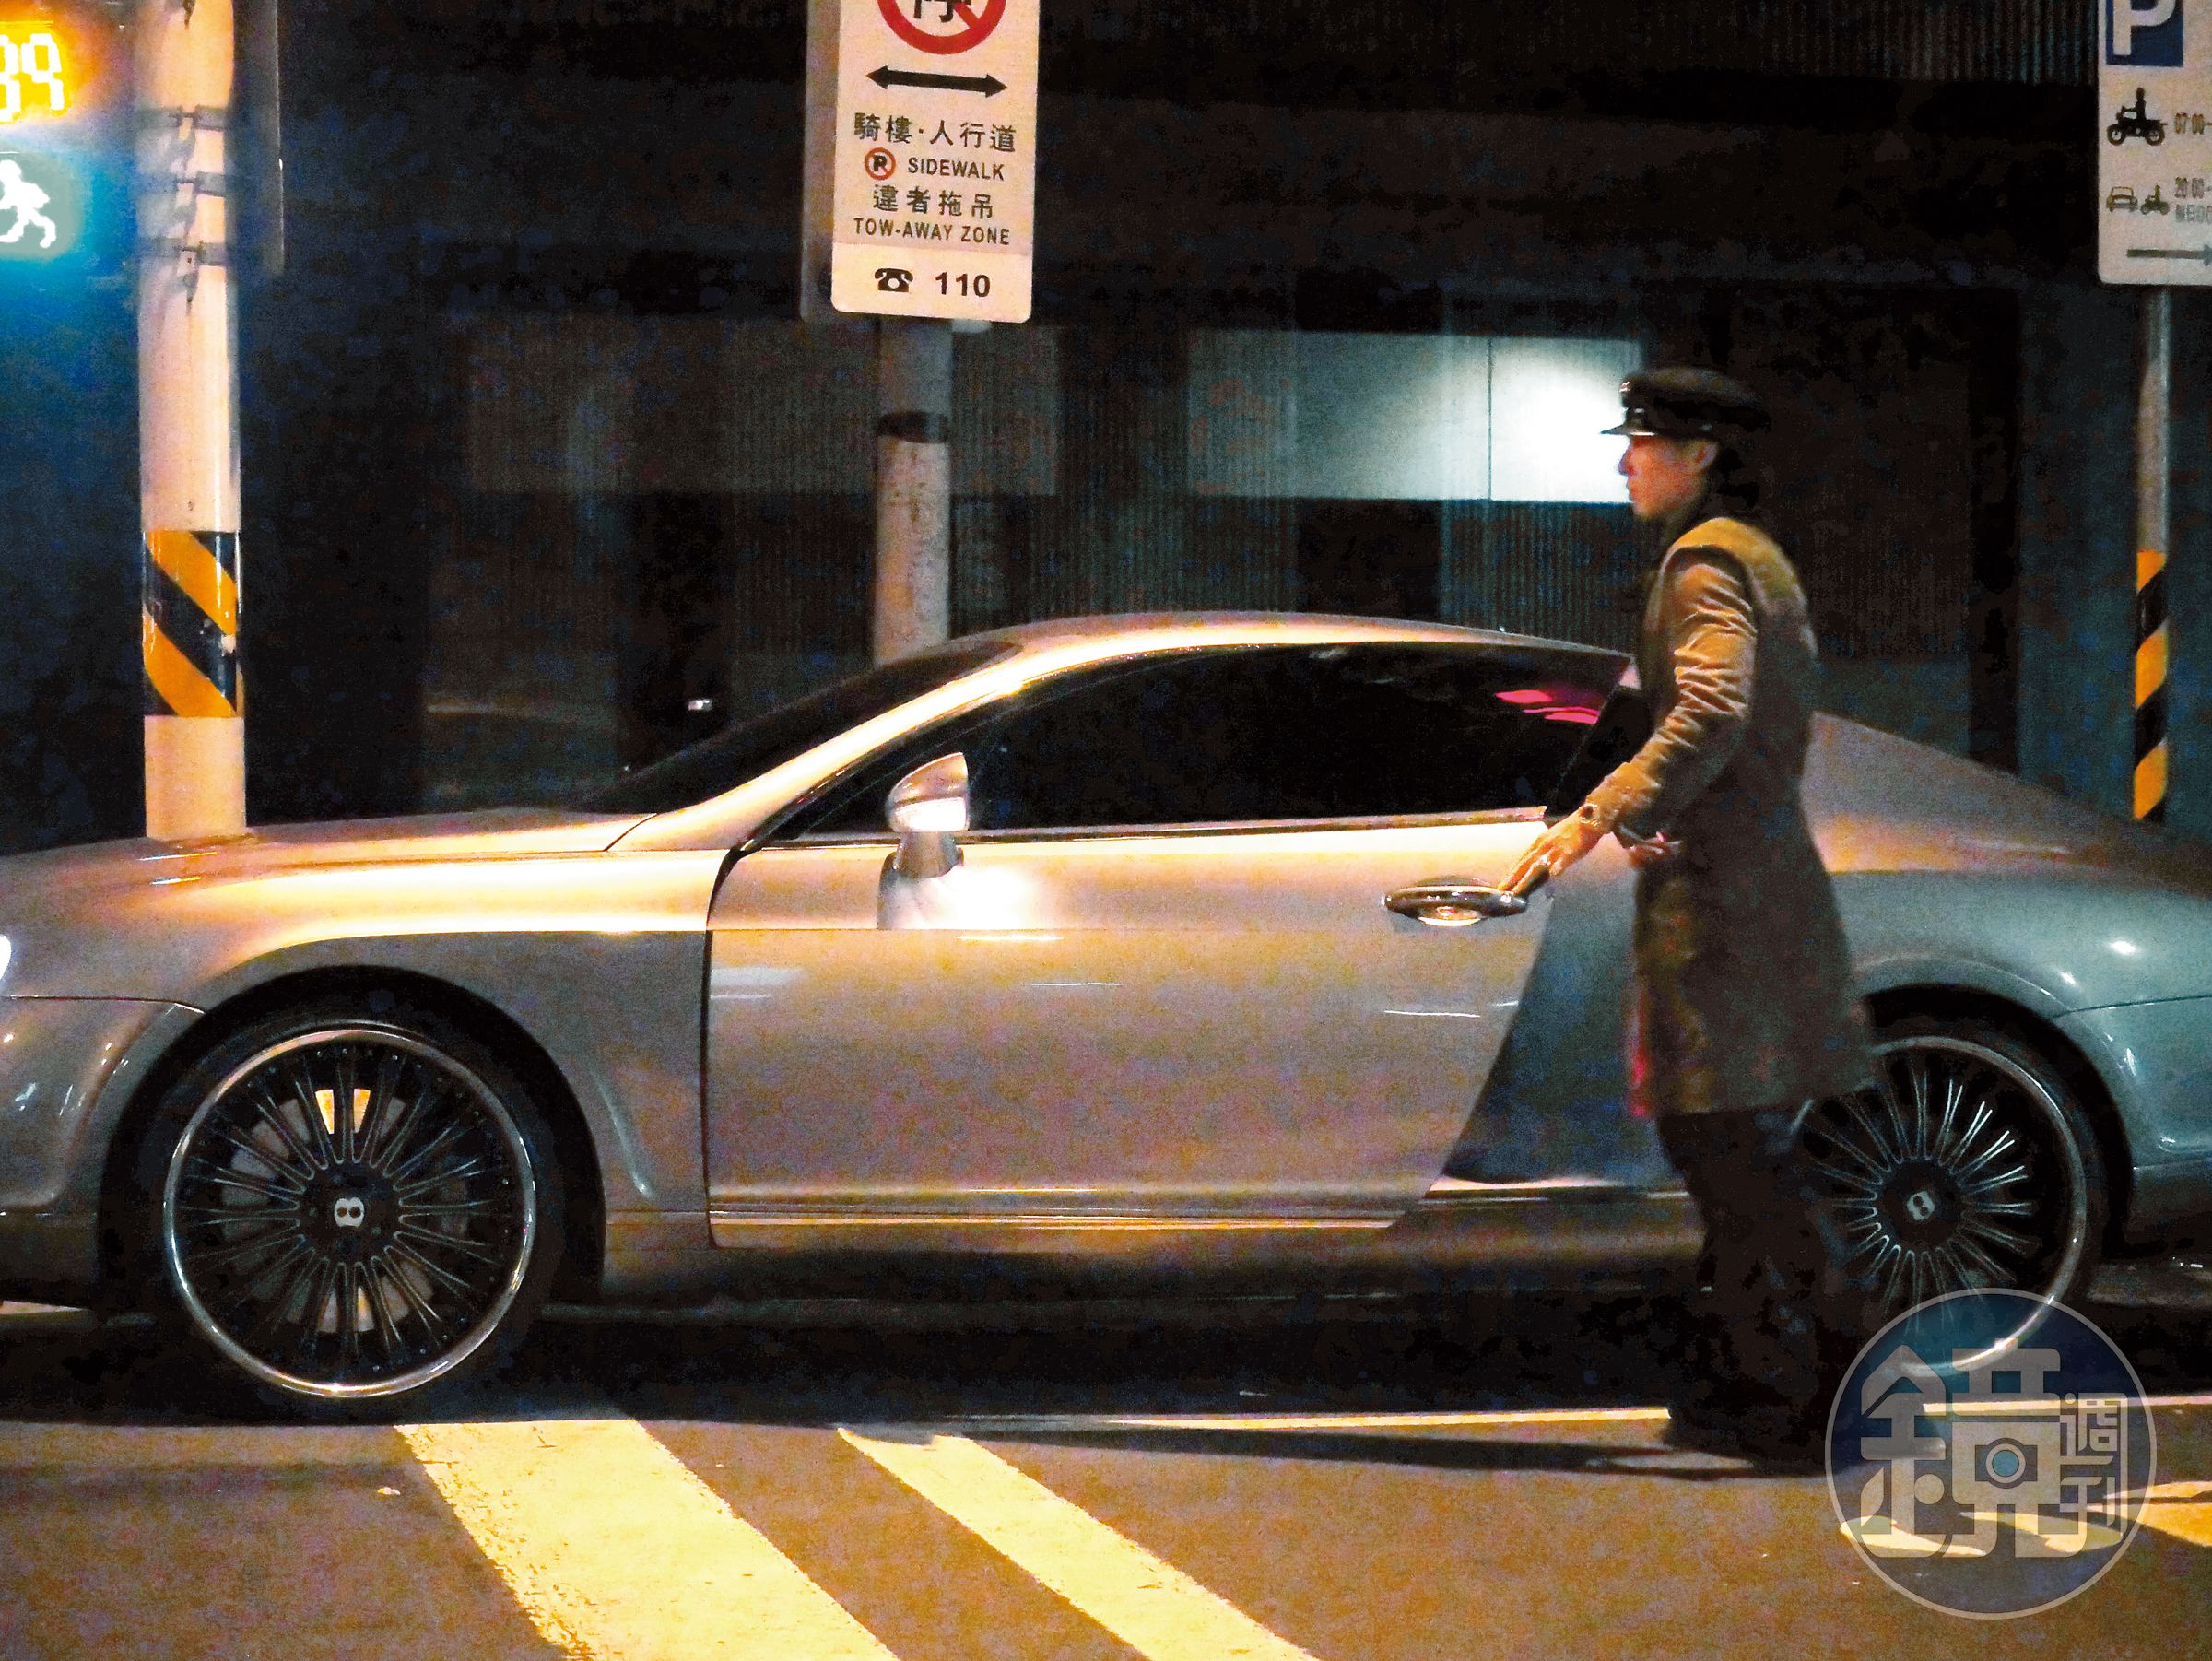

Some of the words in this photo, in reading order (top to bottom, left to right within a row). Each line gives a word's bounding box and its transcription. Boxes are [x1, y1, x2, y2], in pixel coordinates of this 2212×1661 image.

[908, 157, 1005, 182] SIDEWALK
[873, 184, 994, 220] 違者拖吊
[853, 218, 953, 241] TOW-AWAY
[960, 226, 1010, 245] ZONE
[935, 271, 991, 298] 110
